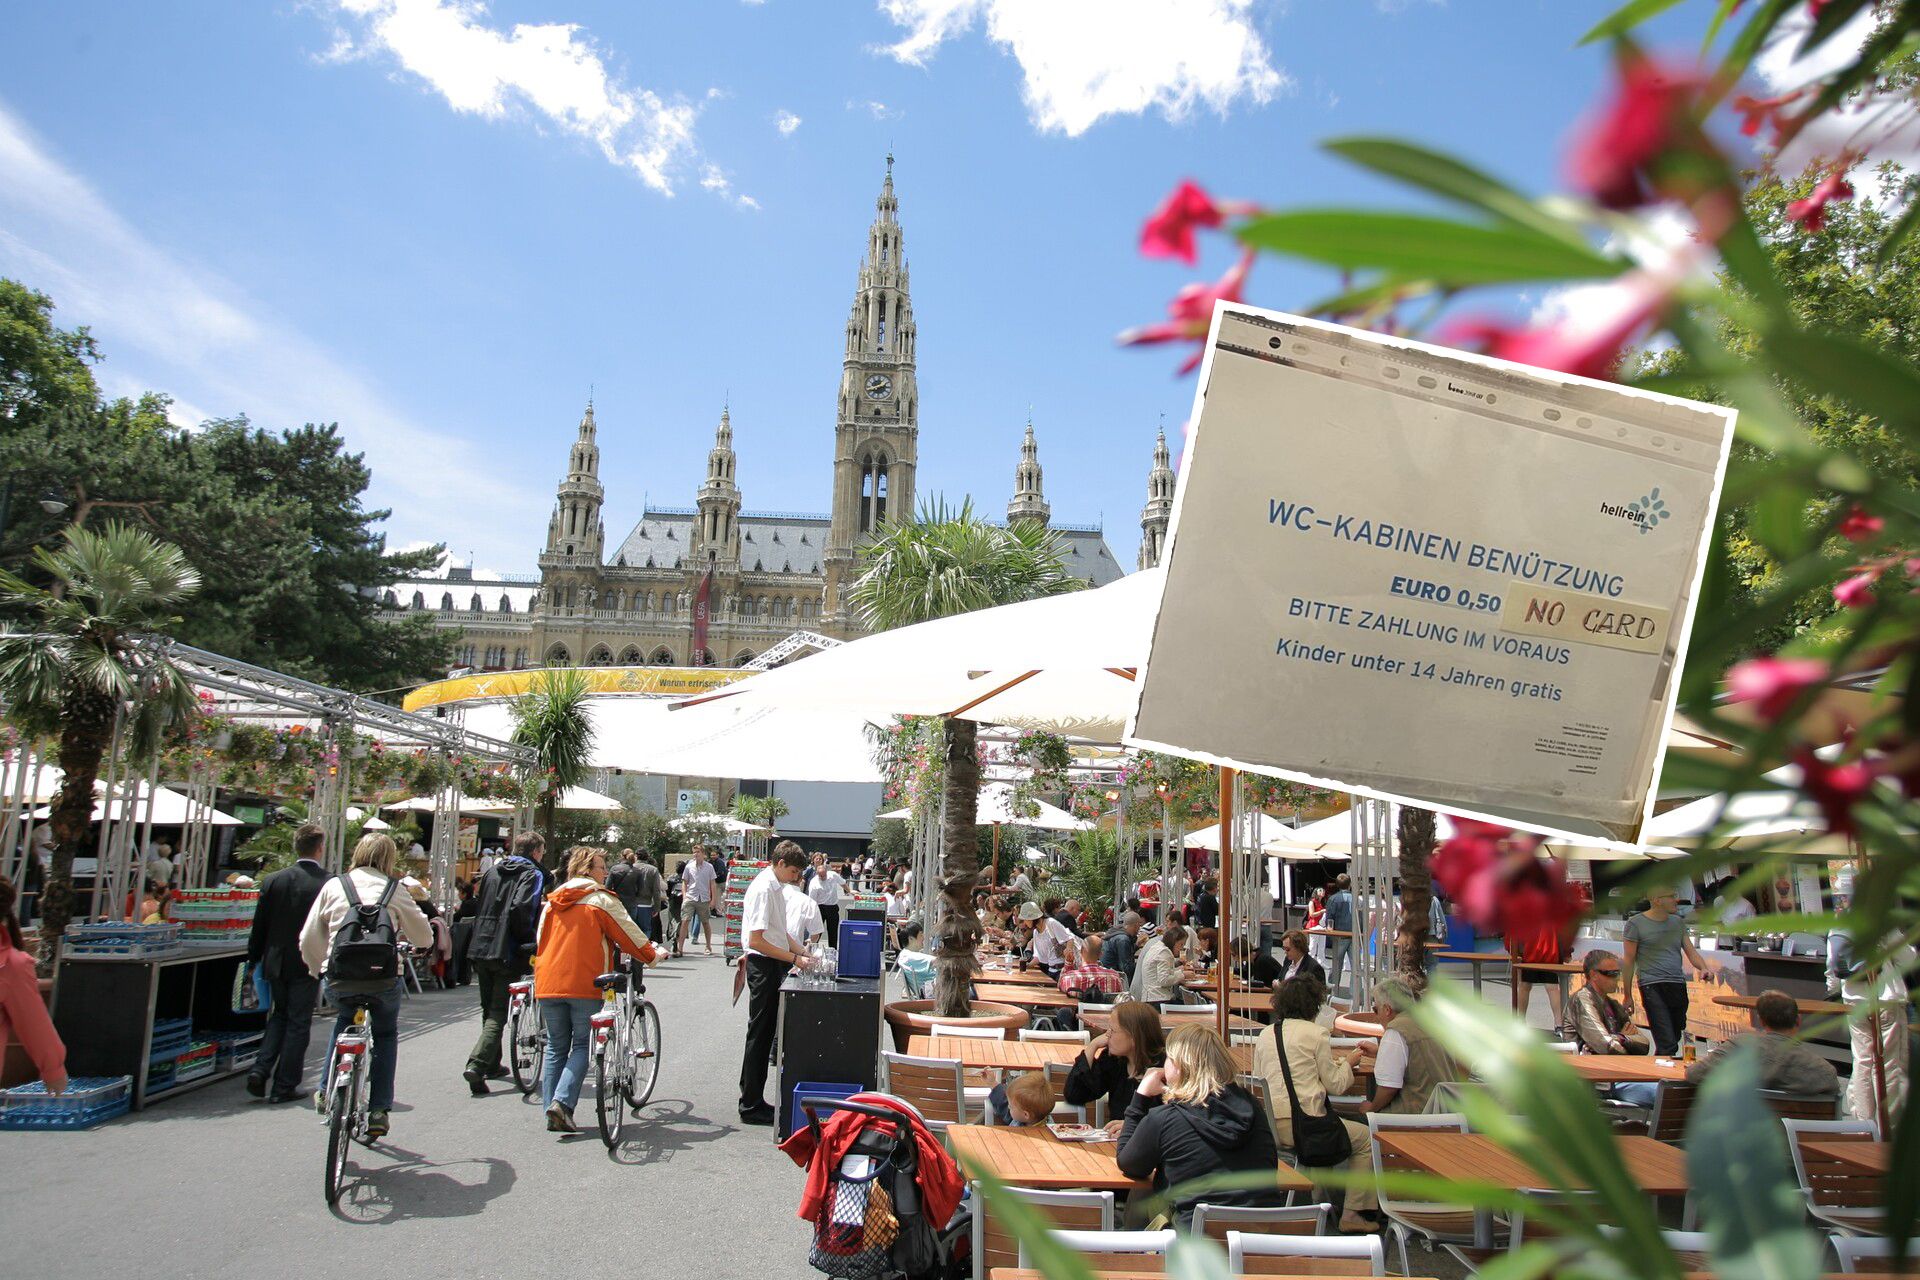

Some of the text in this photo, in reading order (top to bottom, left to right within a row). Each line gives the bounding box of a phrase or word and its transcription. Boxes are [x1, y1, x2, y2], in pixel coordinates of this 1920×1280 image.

[1600, 502, 1645, 523] hellrein
[1269, 499, 1624, 597] WC-KABINEN BENÜTZUNG
[1390, 576, 1502, 612] EURO 0,50
[1524, 598, 1656, 640] NO CARD
[1289, 598, 1571, 664] BITTE ZAHLUNG IM VORAUS
[1276, 638, 1562, 701] Kinder unter 14 Jahren gratis
